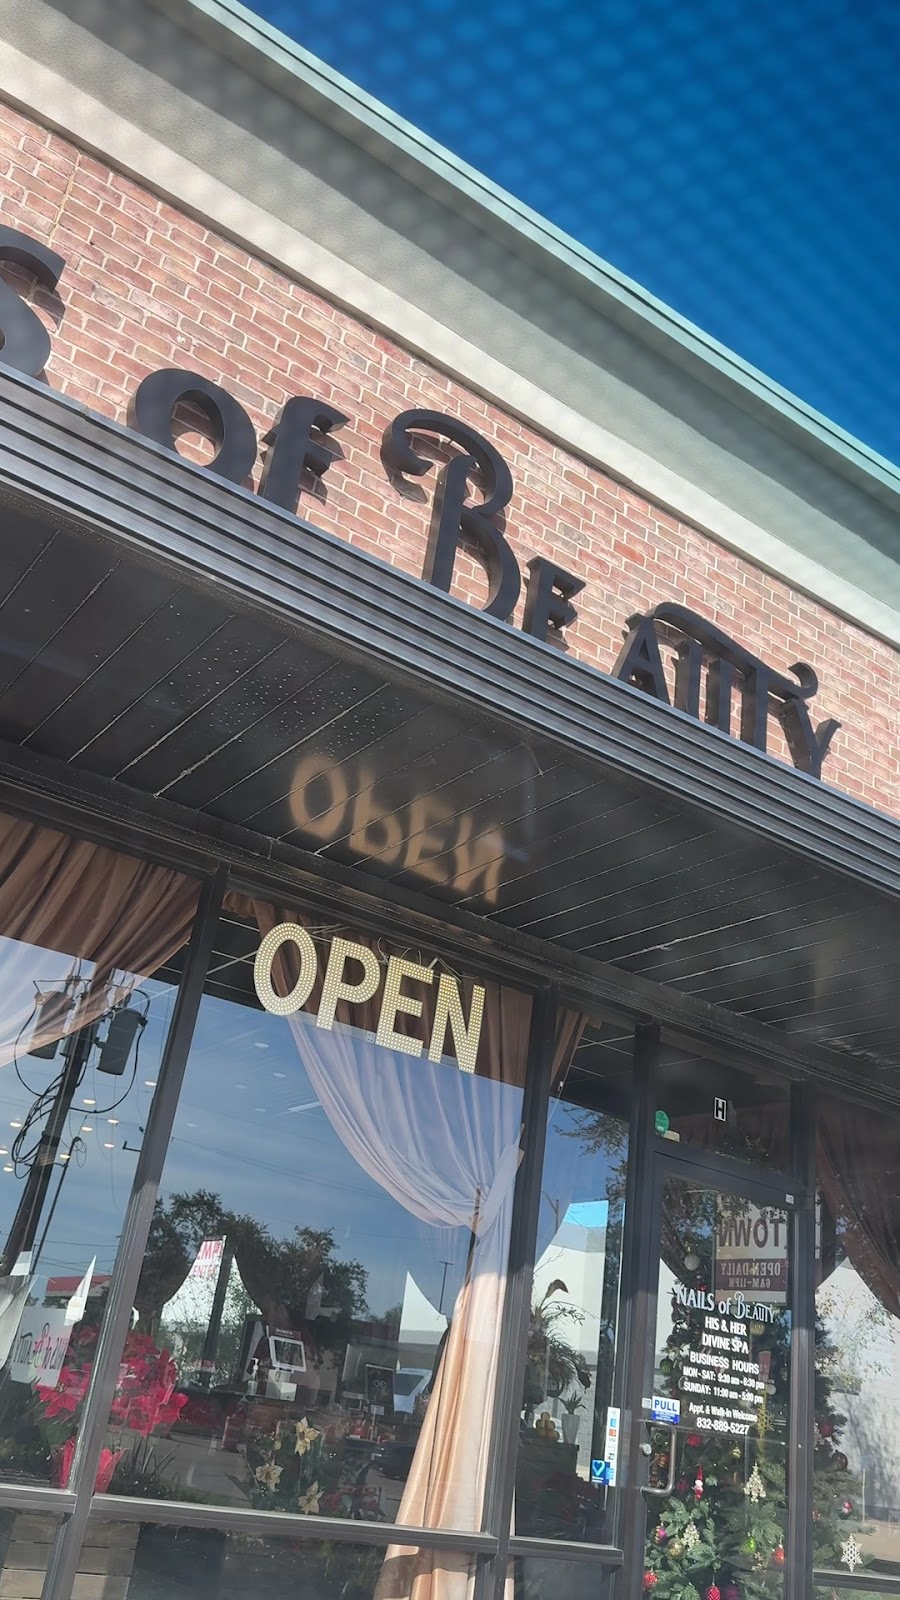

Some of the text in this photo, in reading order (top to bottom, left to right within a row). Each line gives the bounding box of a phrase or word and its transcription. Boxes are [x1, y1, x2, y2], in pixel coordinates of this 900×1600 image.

[254, 922, 486, 1075] OPEN
[675, 1284, 715, 1311] NAILS
[704, 1316, 748, 1337] HIS & HER
[701, 1332, 750, 1354] DIVINE SPA
[690, 1351, 760, 1375] BUSINESS HOURS
[682, 1366, 698, 1378] MON
[701, 1369, 716, 1381] SAT:
[730, 1376, 740, 1385] am
[755, 1381, 765, 1390] pm
[683, 1381, 711, 1395] SUNDAY:
[713, 1386, 729, 1398] 11:00
[729, 1390, 739, 1399] am
[754, 1395, 764, 1405] pm
[654, 1399, 677, 1412] PULL
[705, 1405, 711, 1415] &
